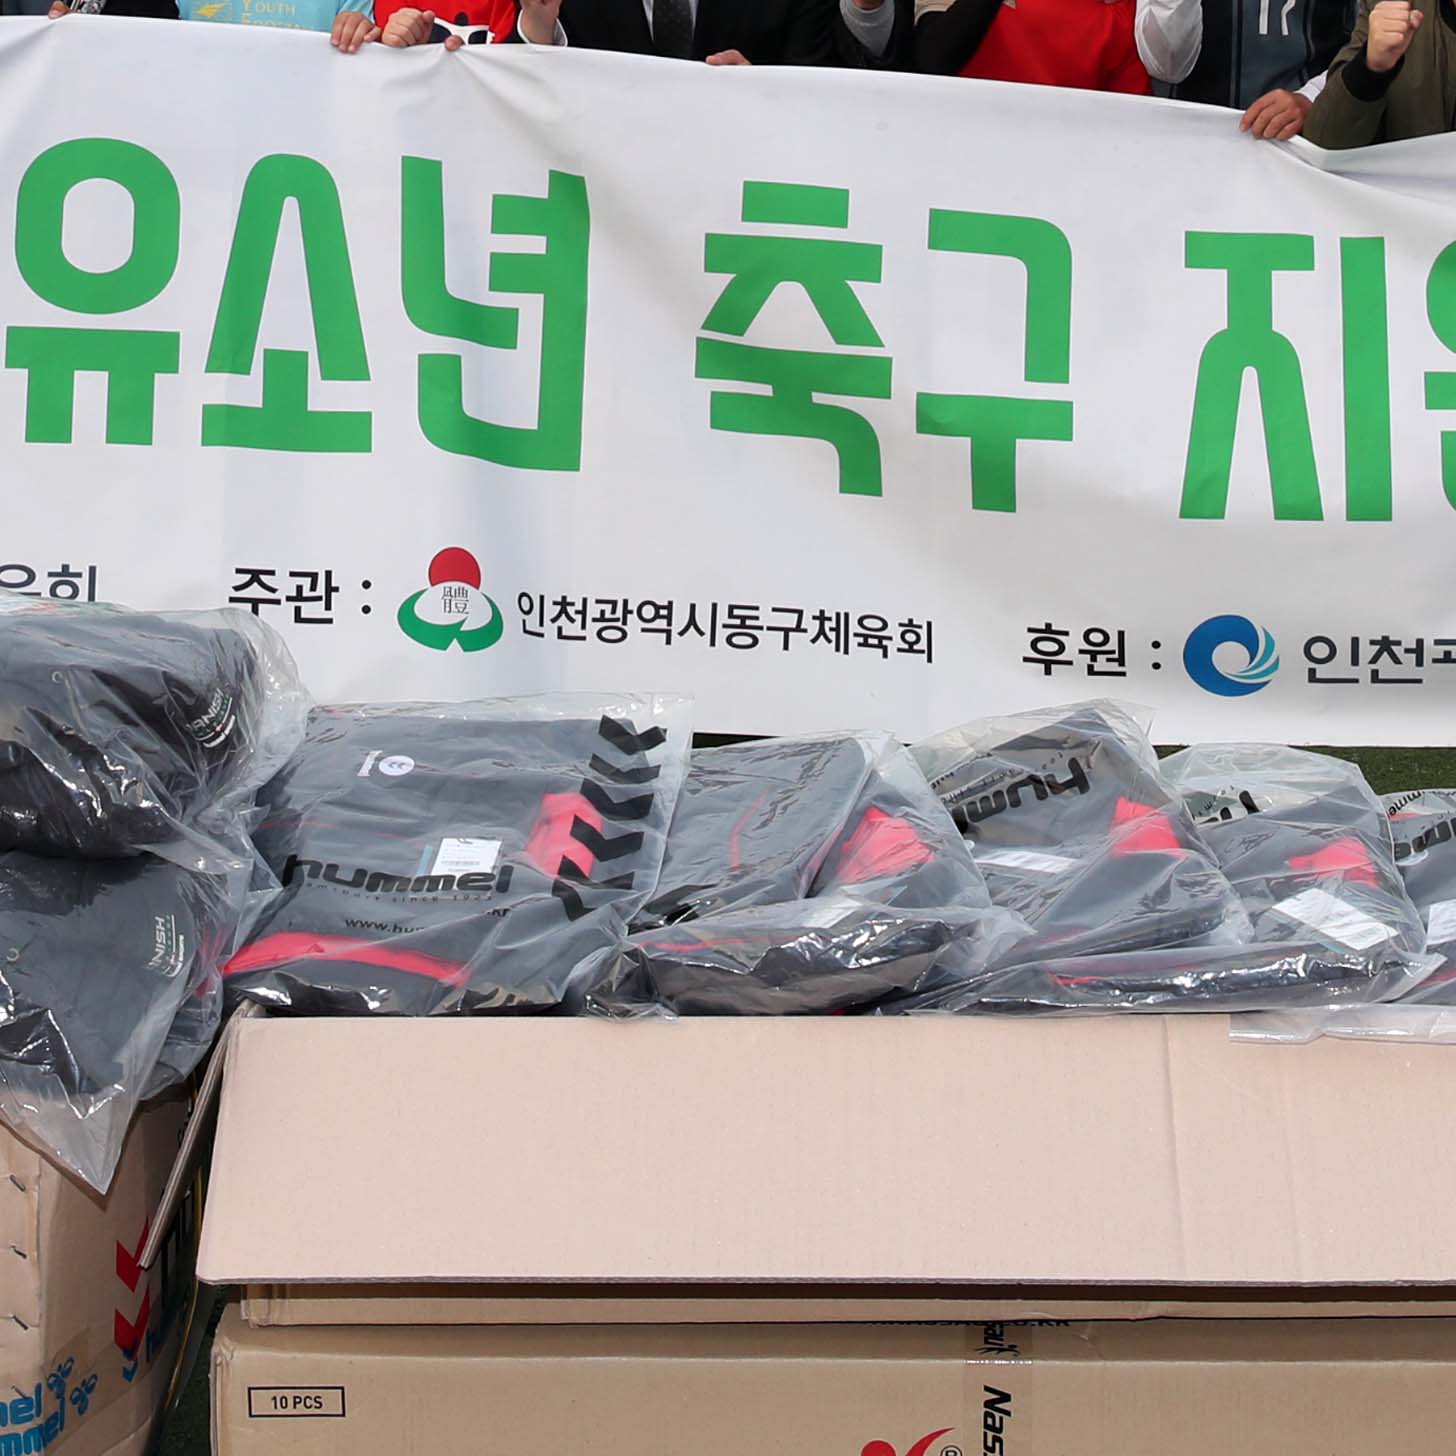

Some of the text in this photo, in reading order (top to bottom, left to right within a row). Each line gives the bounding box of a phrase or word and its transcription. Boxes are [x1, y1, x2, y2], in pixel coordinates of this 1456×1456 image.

[3, 136, 591, 472] 유소년
[693, 178, 1075, 515] 축구
[227, 567, 340, 626] 주관
[516, 590, 934, 664] 인천광역시동구체육회
[1021, 621, 1129, 678] 후원
[185, 686, 225, 733] ANISH
[281, 853, 515, 894] hummel
[271, 1395, 324, 1410] 10 PCS
[982, 1384, 1013, 1456] Nas
